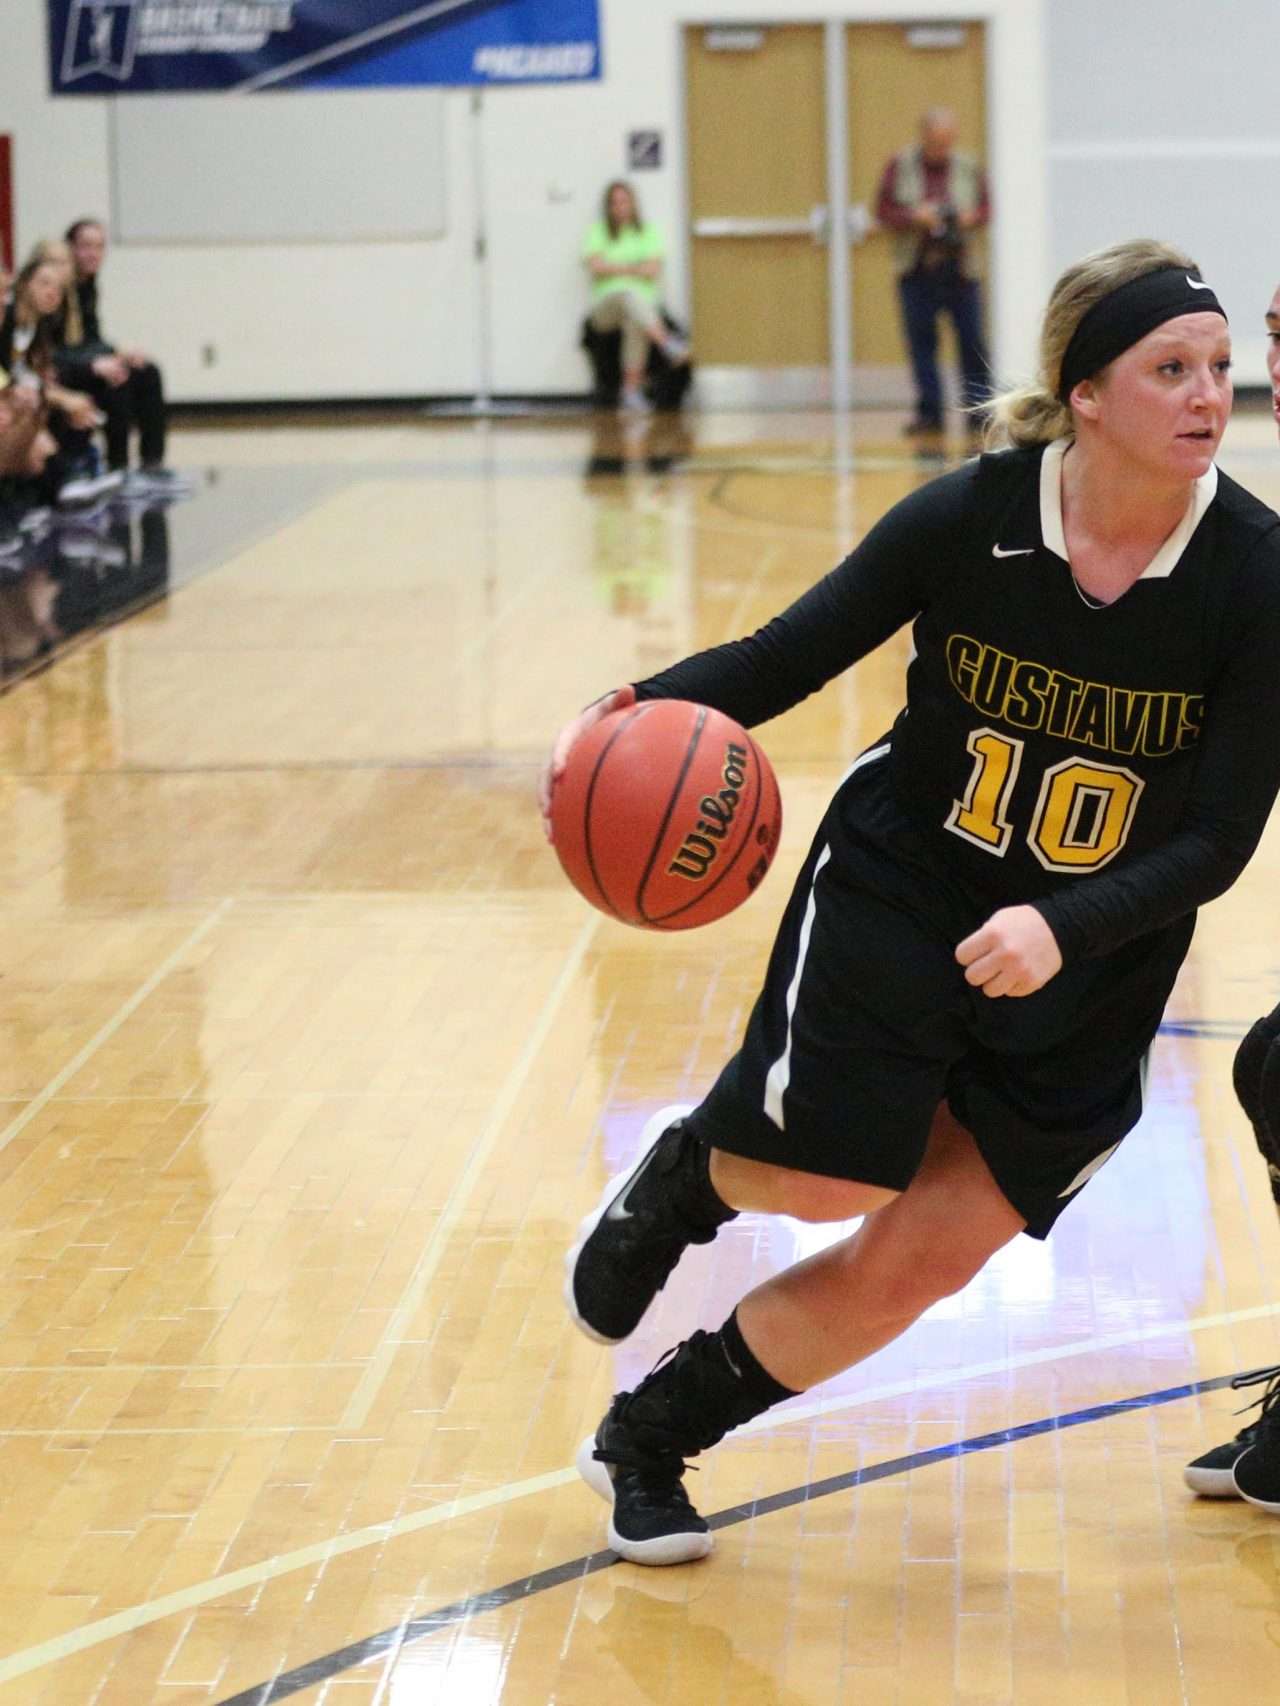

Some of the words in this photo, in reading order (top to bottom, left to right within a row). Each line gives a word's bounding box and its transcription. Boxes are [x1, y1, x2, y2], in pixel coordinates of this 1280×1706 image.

[946, 634, 1205, 757] GUSTAVUS
[666, 742, 748, 881] Wilson
[943, 727, 1146, 874] 10
